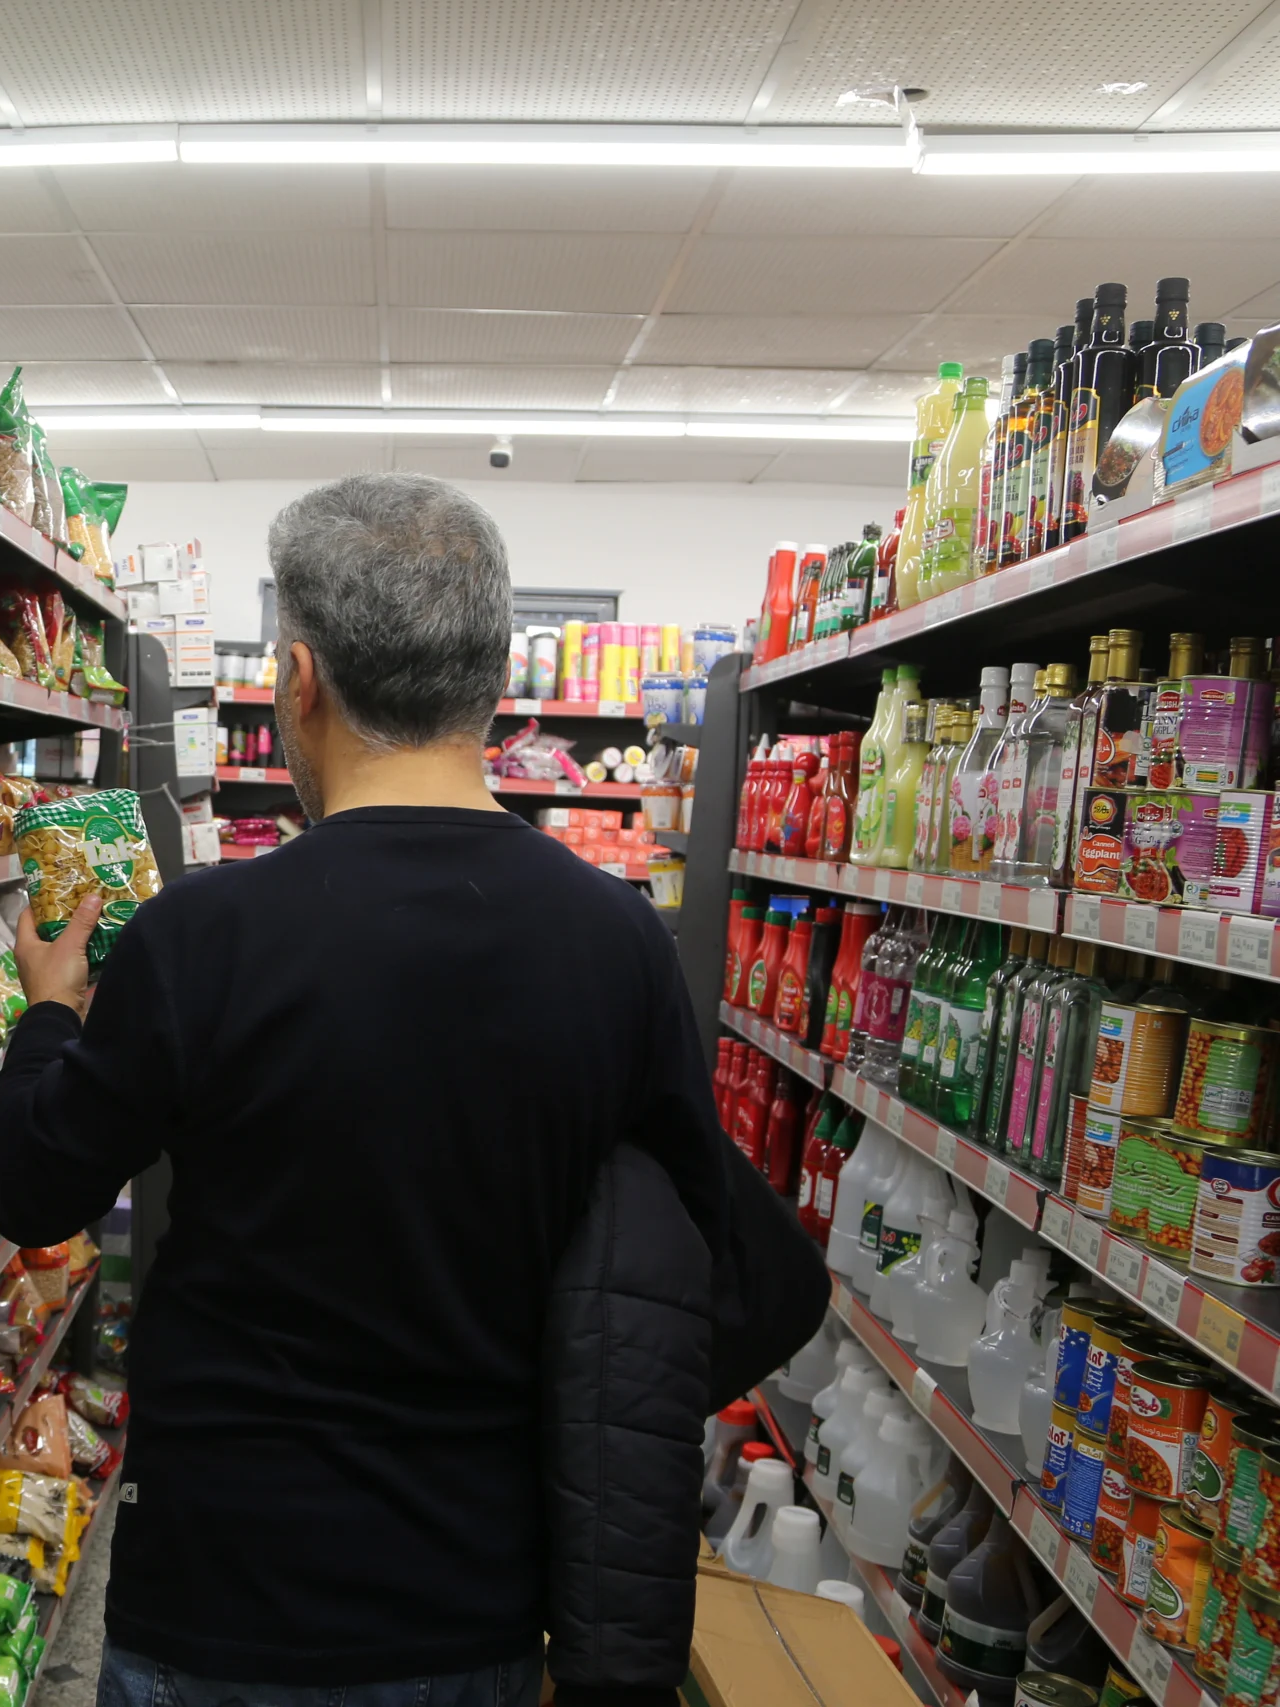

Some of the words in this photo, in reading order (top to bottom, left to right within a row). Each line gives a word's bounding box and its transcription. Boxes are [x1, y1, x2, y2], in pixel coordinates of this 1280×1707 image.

[1092, 840, 1114, 848] Canned
[78, 836, 134, 868] Tak
[1082, 848, 1120, 860] Eggplant
[27, 869, 45, 885] ak
